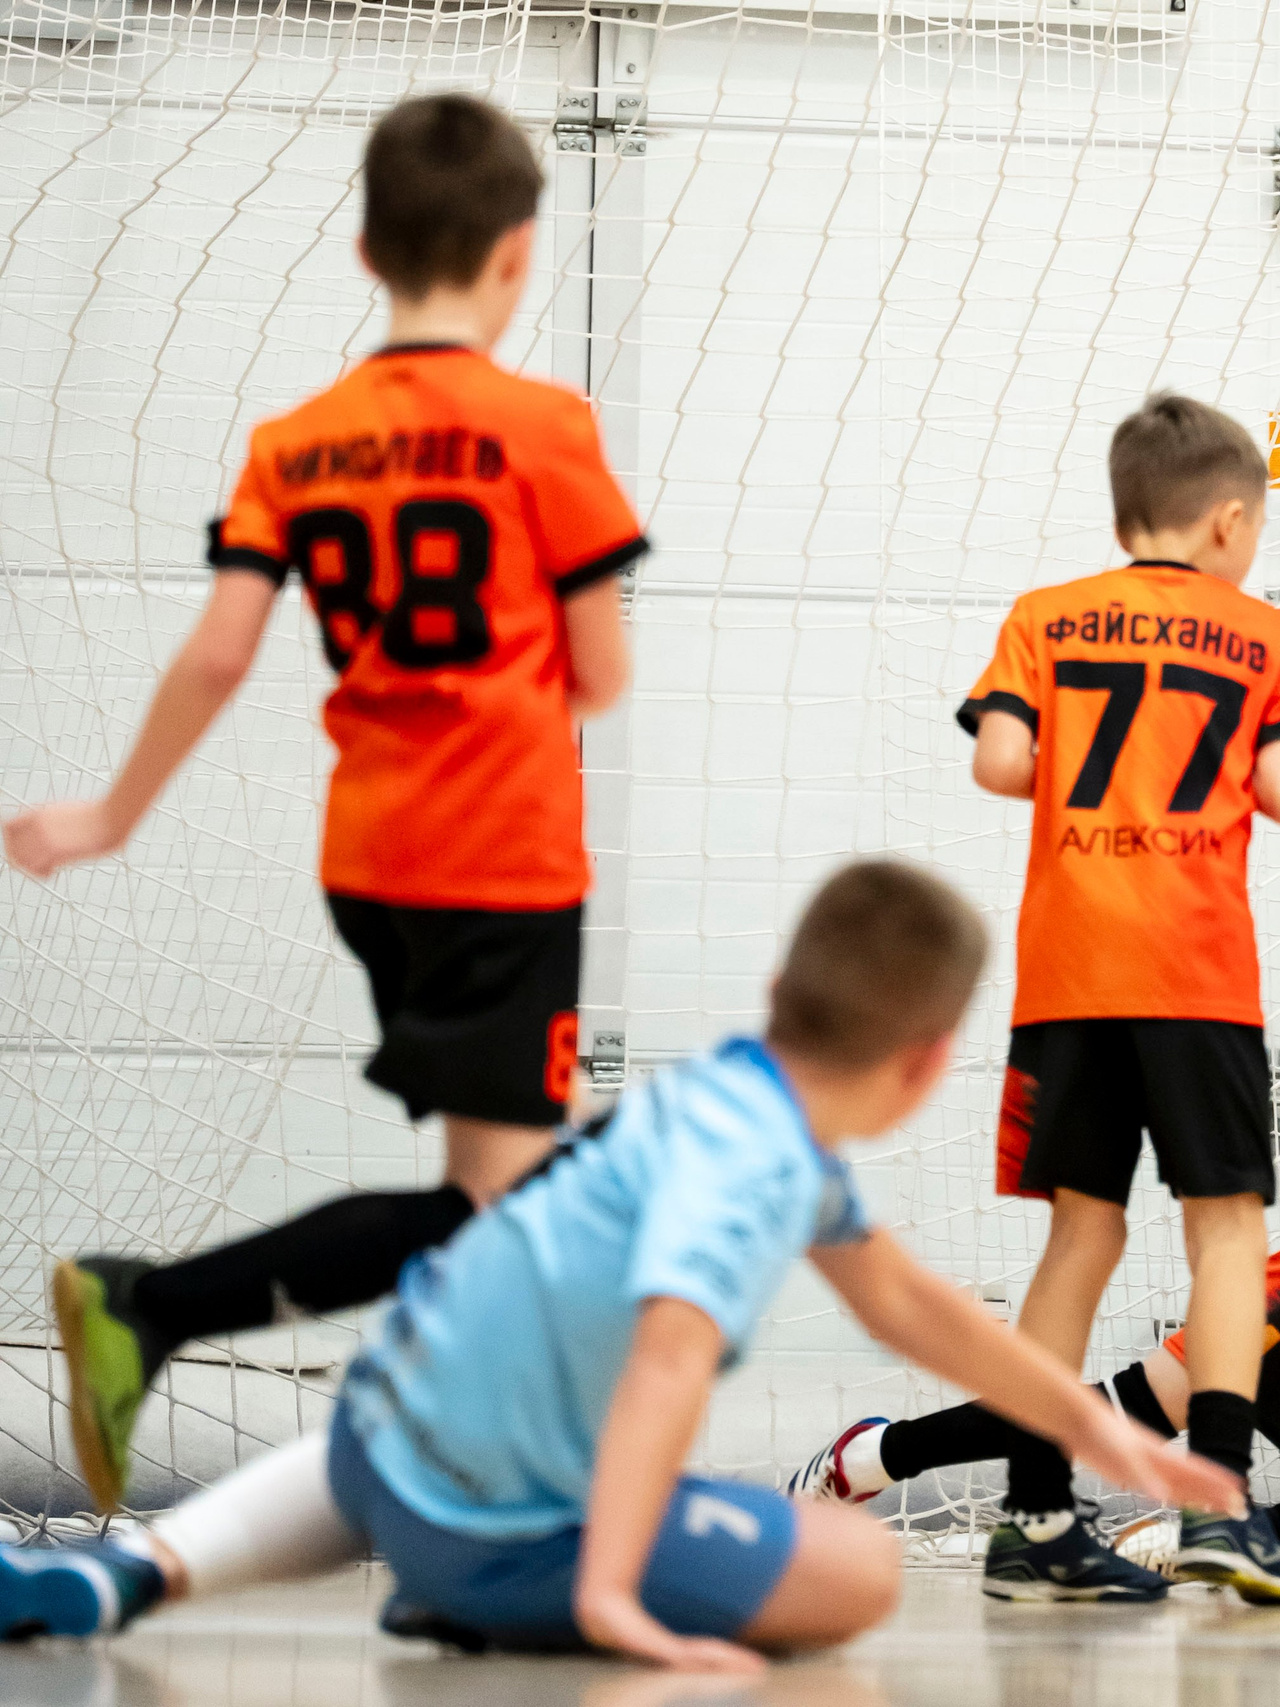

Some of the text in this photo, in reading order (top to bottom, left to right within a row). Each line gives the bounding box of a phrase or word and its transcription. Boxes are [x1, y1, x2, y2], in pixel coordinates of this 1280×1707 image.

[286, 498, 491, 673] 88
[1053, 659, 1249, 815] 77
[684, 1492, 761, 1546] 7
